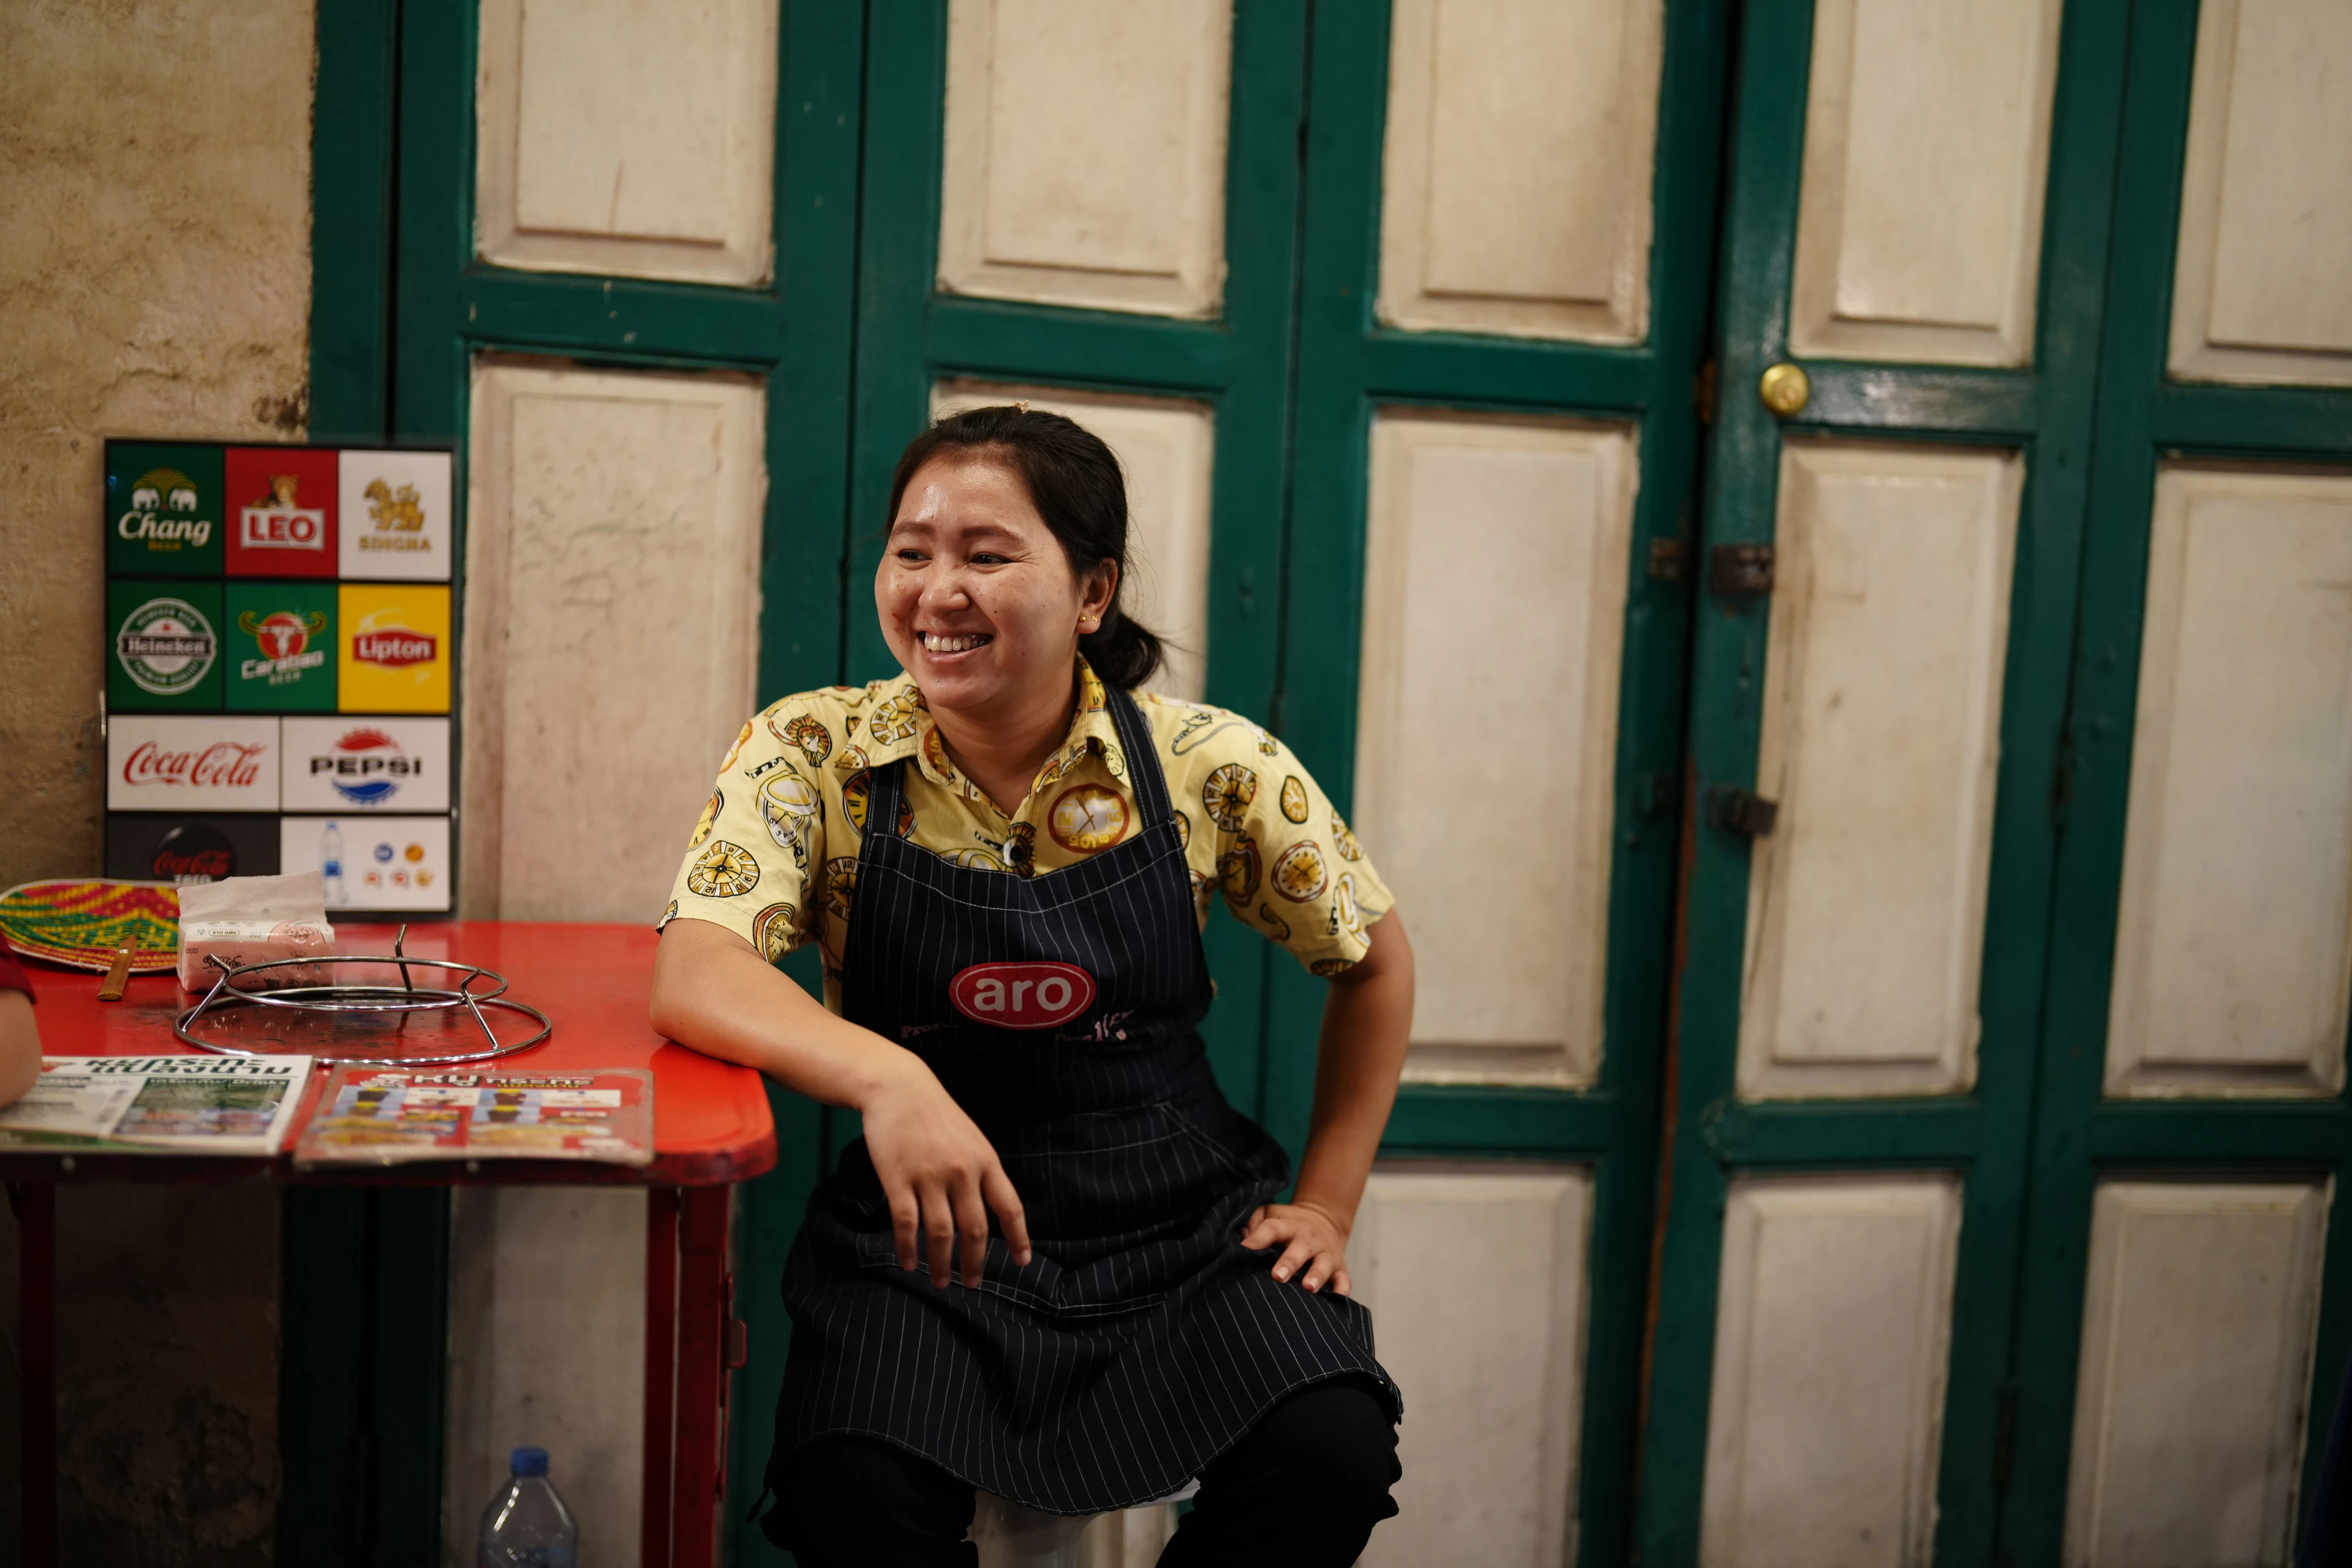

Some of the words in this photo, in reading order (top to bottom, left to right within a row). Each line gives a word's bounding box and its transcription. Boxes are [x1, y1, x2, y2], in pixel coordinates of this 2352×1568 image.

[118, 511, 212, 547] Chang
[249, 514, 315, 541] LEO
[129, 636, 206, 654] Heineken
[359, 636, 431, 661] Lipton
[310, 756, 421, 777] PEPSI
[973, 977, 1072, 1012] aro
